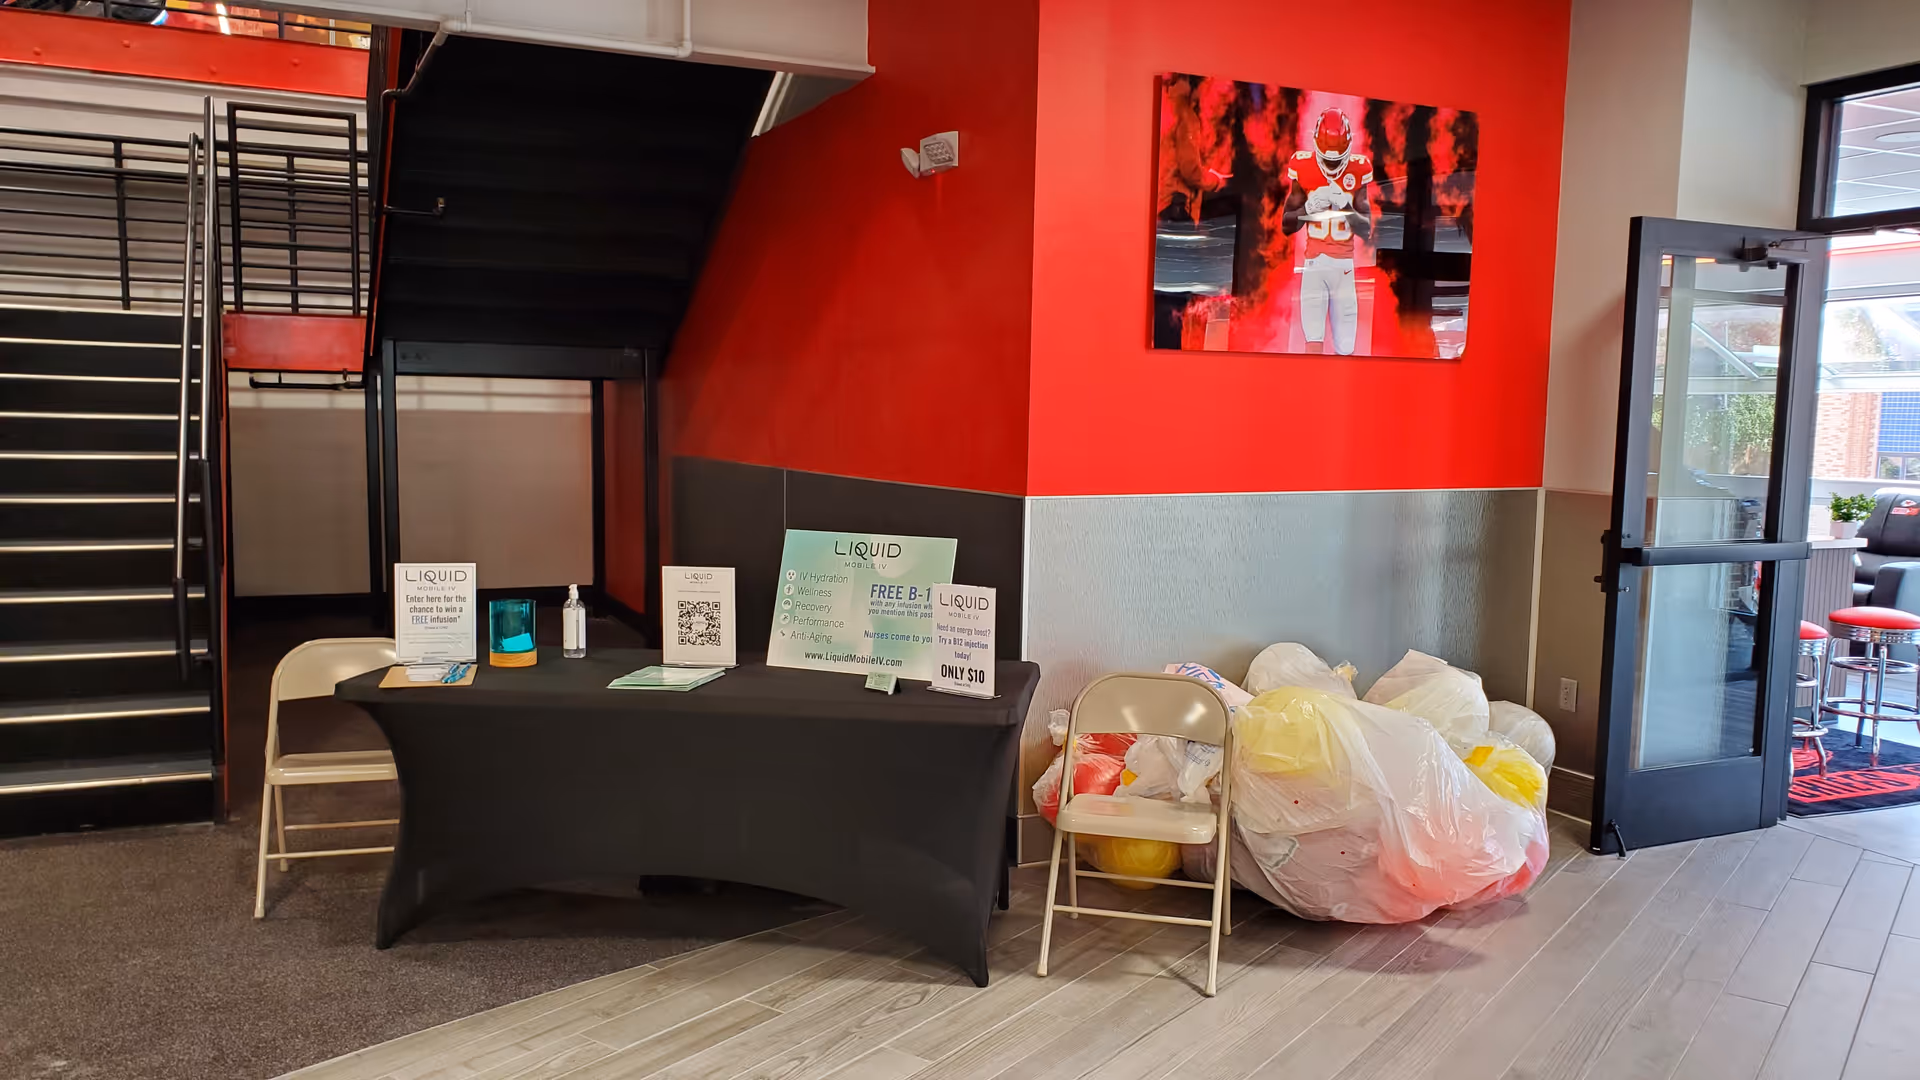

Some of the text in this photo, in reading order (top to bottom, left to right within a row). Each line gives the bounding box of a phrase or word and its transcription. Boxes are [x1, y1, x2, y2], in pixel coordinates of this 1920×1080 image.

[834, 540, 902, 561] LIQUID
[844, 561, 876, 569] MOBILE
[406, 570, 468, 584] LIQUID
[684, 572, 713, 581] LIQUID
[799, 572, 849, 584] IV Hydration
[797, 586, 832, 598] Wellness
[870, 584, 904, 600] FREE
[406, 594, 467, 603] Enter here for the
[870, 599, 883, 607] with
[884, 601, 895, 609] any
[897, 601, 922, 609] infusion
[939, 592, 989, 611] LIQUID
[409, 605, 434, 613] chance
[436, 605, 443, 613] to
[445, 605, 457, 613] win
[795, 601, 832, 614] Recovery
[868, 608, 880, 616] you
[880, 608, 906, 617] mention
[906, 609, 919, 617] this
[411, 616, 428, 625] FREE
[948, 611, 972, 620] MOBILE
[792, 615, 845, 629] Performance
[863, 630, 889, 640] Nurses
[890, 633, 911, 642] come
[912, 633, 920, 642] to
[936, 622, 991, 638] Need an energy boost?
[790, 630, 833, 645] Anti-Aging
[938, 635, 947, 645] Try
[953, 637, 963, 646] B12
[964, 638, 989, 650] injection
[804, 651, 903, 668] www.LiquidMobileIV.com
[954, 651, 972, 661] today!
[941, 663, 985, 684] ONLY $10
